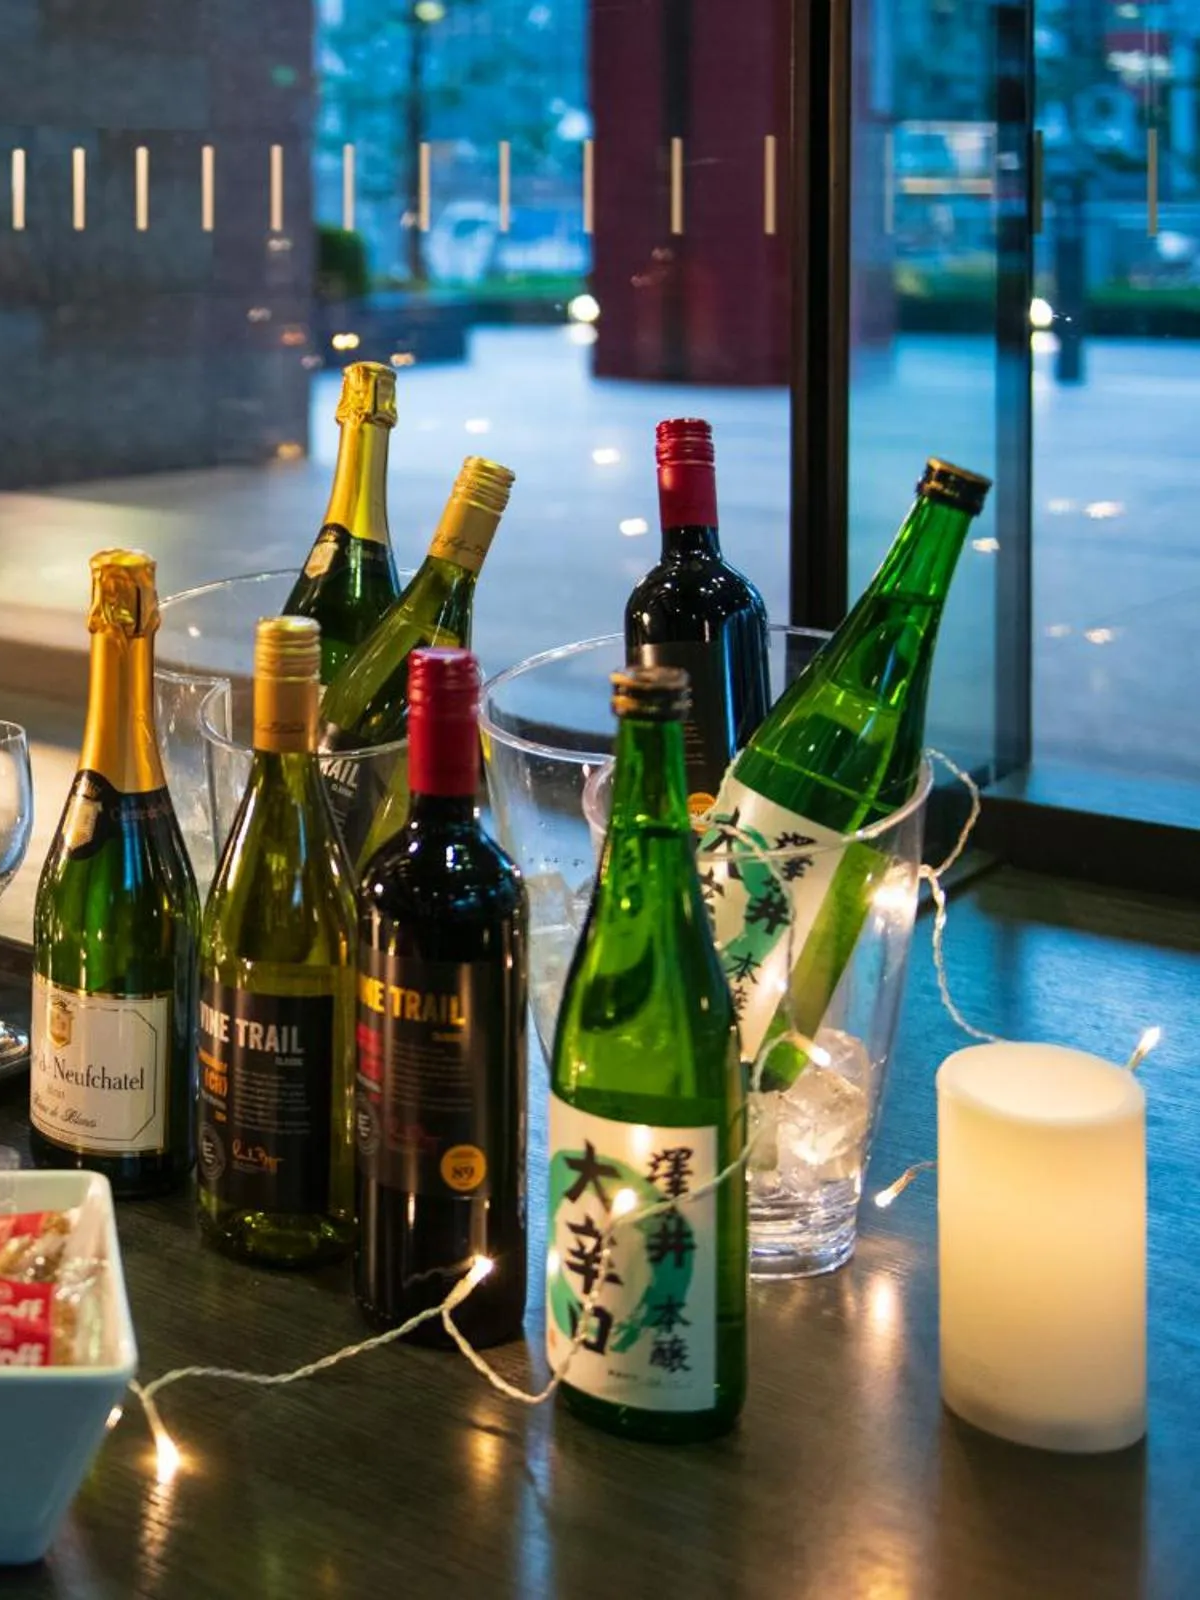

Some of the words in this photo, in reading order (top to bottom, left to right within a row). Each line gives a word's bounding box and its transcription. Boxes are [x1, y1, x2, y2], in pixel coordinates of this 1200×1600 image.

[388, 985, 466, 1026] TRAIL
[235, 1018, 305, 1054] TRAIL
[54, 1056, 145, 1091] Neufchatel
